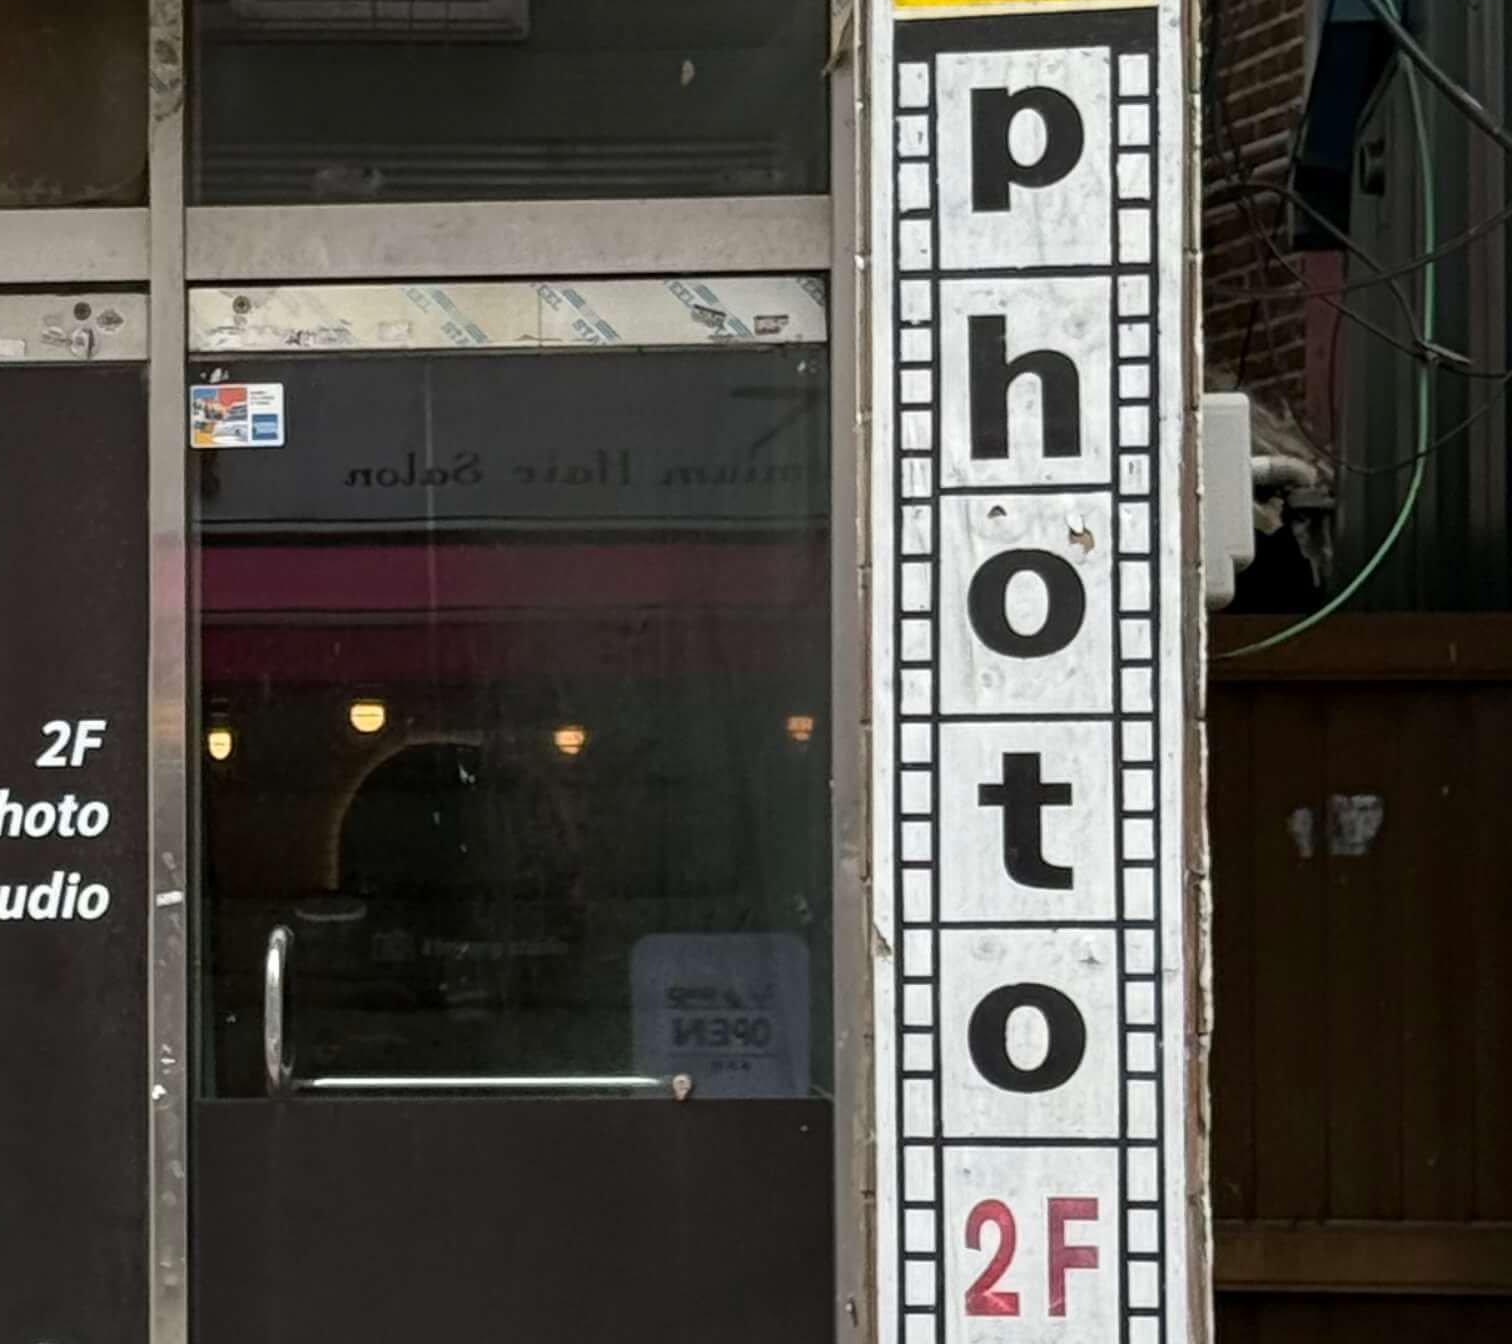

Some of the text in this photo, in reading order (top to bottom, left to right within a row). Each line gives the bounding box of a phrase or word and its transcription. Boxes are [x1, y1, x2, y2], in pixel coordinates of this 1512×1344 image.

[967, 85, 1088, 1093] photo
[35, 720, 107, 768] 2F
[964, 1196, 1100, 1317] 2F
